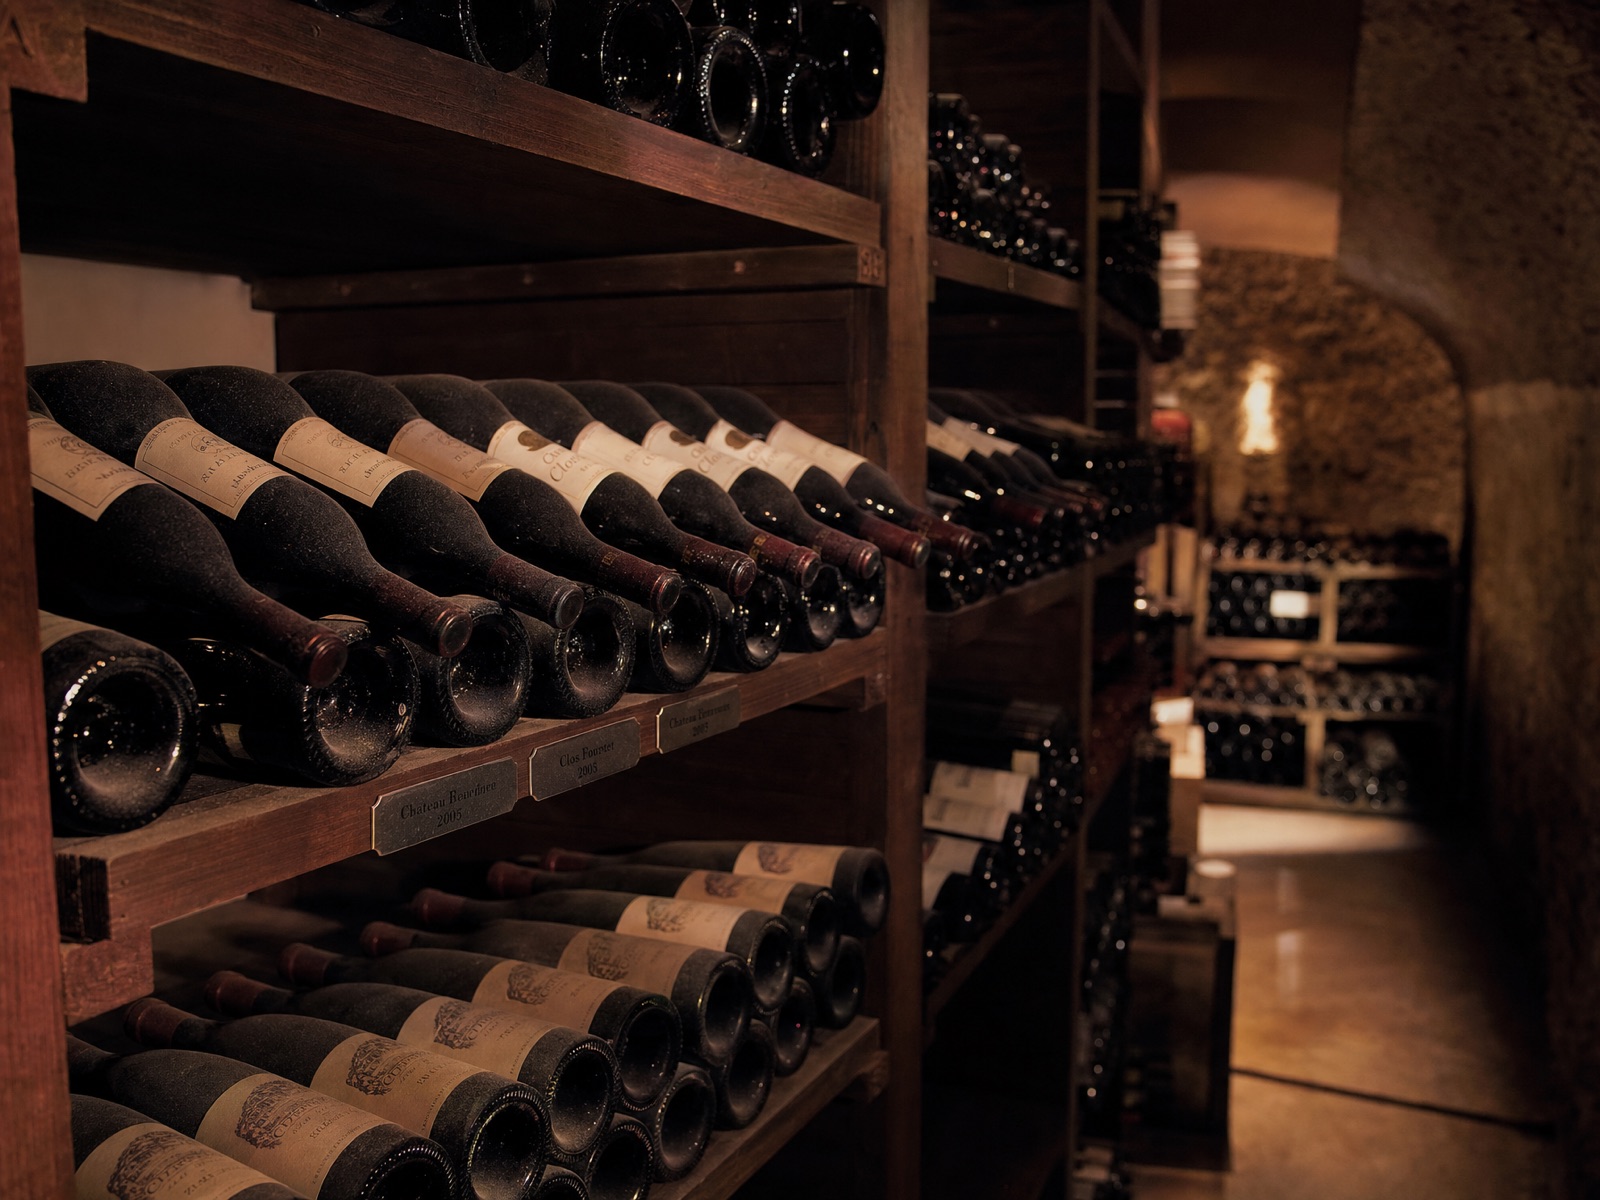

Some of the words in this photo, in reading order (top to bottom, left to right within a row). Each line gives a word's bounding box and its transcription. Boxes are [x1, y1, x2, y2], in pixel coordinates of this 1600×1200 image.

[559, 754, 580, 768] Clos
[400, 798, 446, 820] Chateau
[437, 807, 463, 828] 2005
